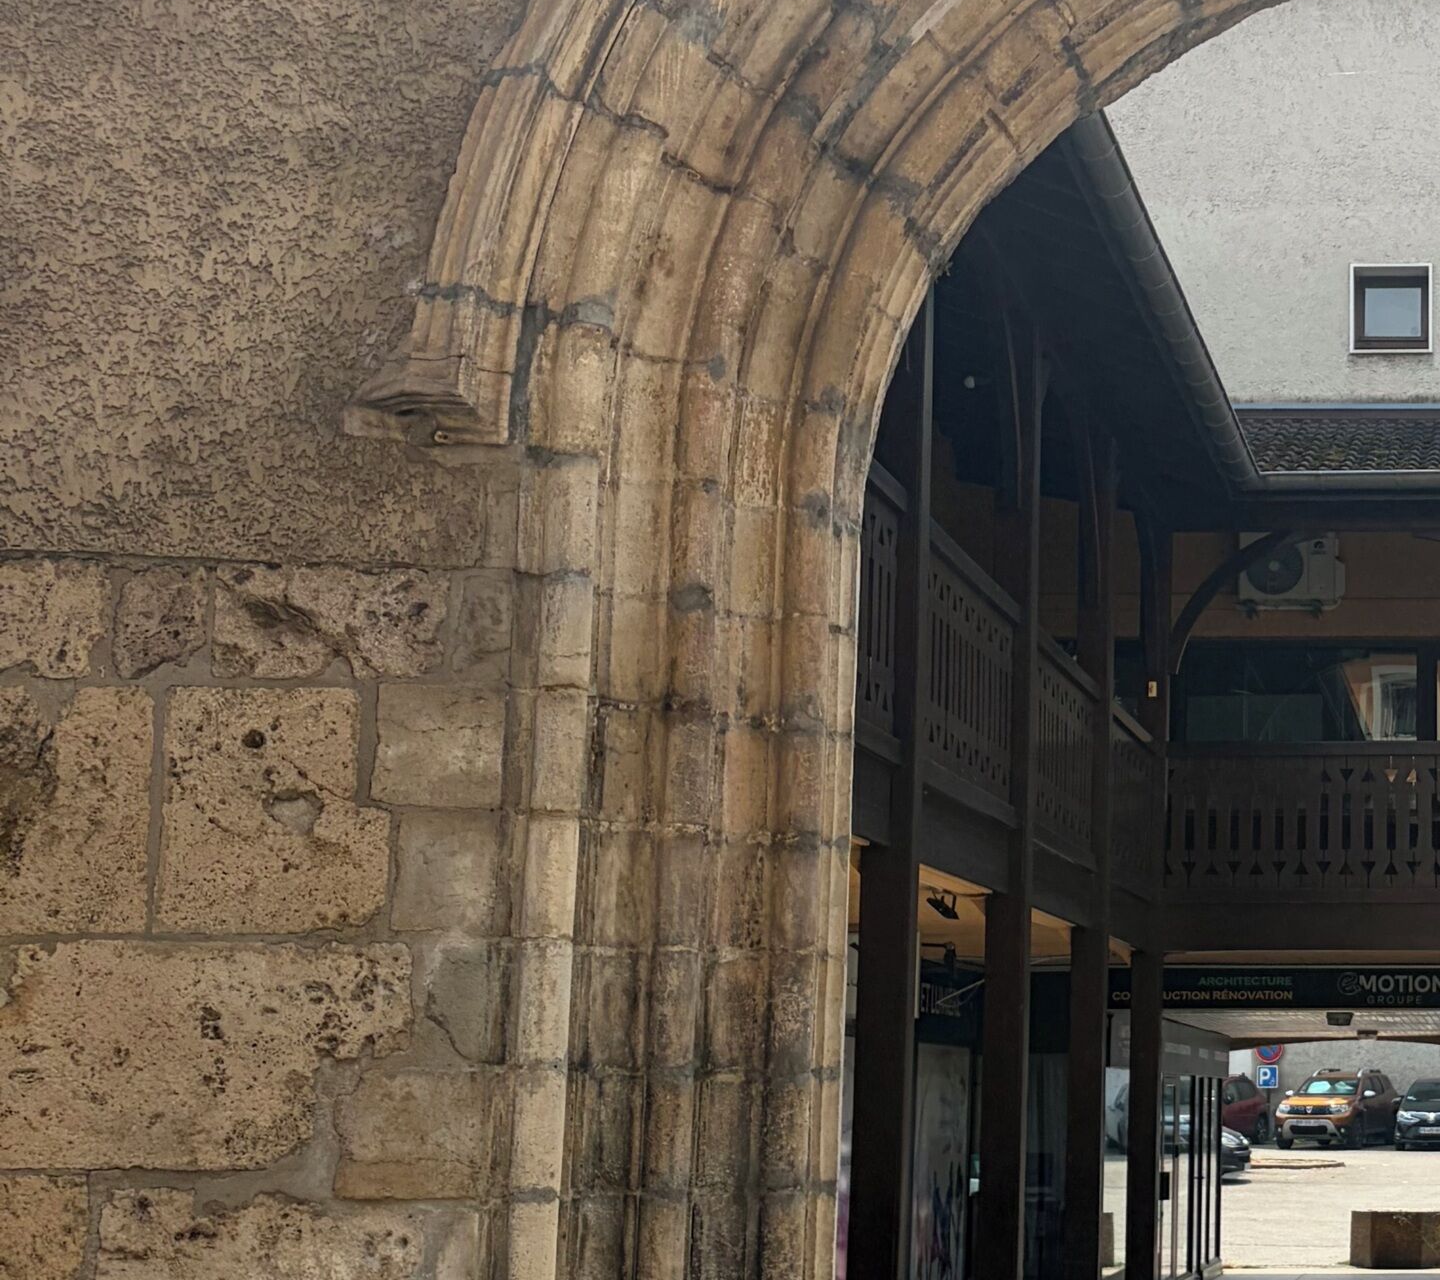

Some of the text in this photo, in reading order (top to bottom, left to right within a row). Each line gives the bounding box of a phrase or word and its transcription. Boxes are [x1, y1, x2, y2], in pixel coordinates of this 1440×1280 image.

[1198, 976, 1293, 986] ARCHITECTURE
[1112, 988, 1293, 1001] COUCTION RÉNOVATION
[1366, 995, 1424, 1005] GROUPE
[1260, 1067, 1271, 1085] P
